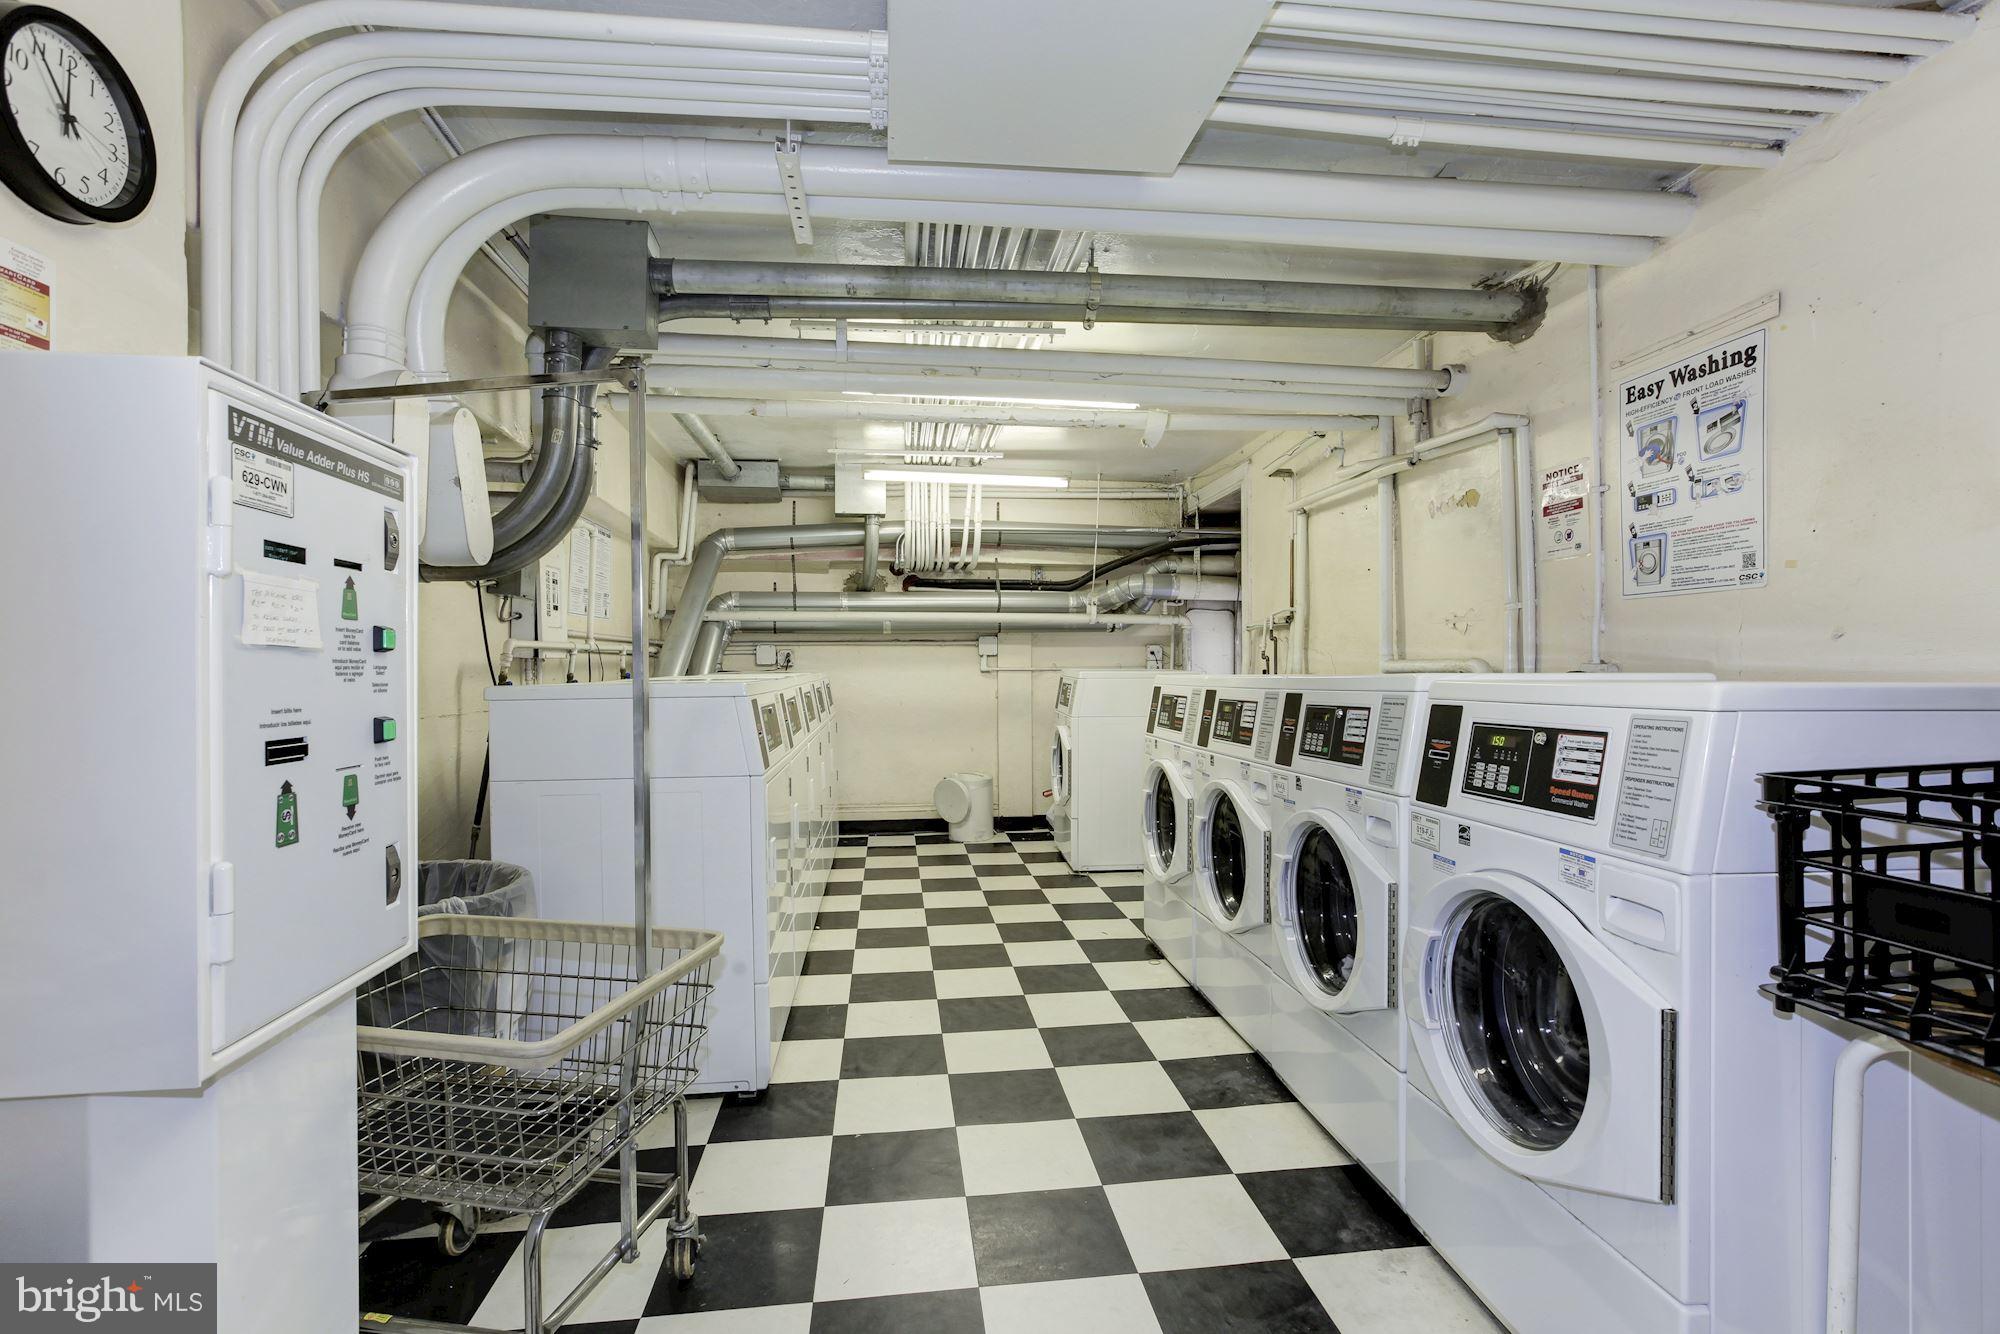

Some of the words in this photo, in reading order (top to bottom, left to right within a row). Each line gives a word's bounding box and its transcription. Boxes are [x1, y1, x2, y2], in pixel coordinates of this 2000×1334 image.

[9, 42, 28, 70] 10
[90, 79, 95, 97] 1
[103, 112, 114, 133] 2
[108, 143, 118, 163] 3
[54, 167, 66, 187] 6
[79, 175, 90, 194] 5
[98, 168, 108, 186] 4
[1625, 379, 1665, 405] Easy
[1669, 344, 1758, 389] Washing
[1625, 396, 1673, 418] HIGH-EFFICIENCY
[1682, 384, 1704, 399] FRONT
[1705, 378, 1724, 392] LOAD
[1725, 367, 1757, 383] WASHER
[231, 411, 275, 449] VTM
[276, 437, 305, 460] Value
[306, 450, 336, 472] Adder
[337, 460, 357, 480] Plus
[357, 467, 371, 484] HS
[234, 447, 251, 459] CSC
[242, 470, 288, 495] 629-CWN
[1545, 464, 1580, 482] NOTICE
[1738, 572, 1758, 581] CSC
[1549, 785, 1571, 796] Speed
[1571, 789, 1595, 801] Queen
